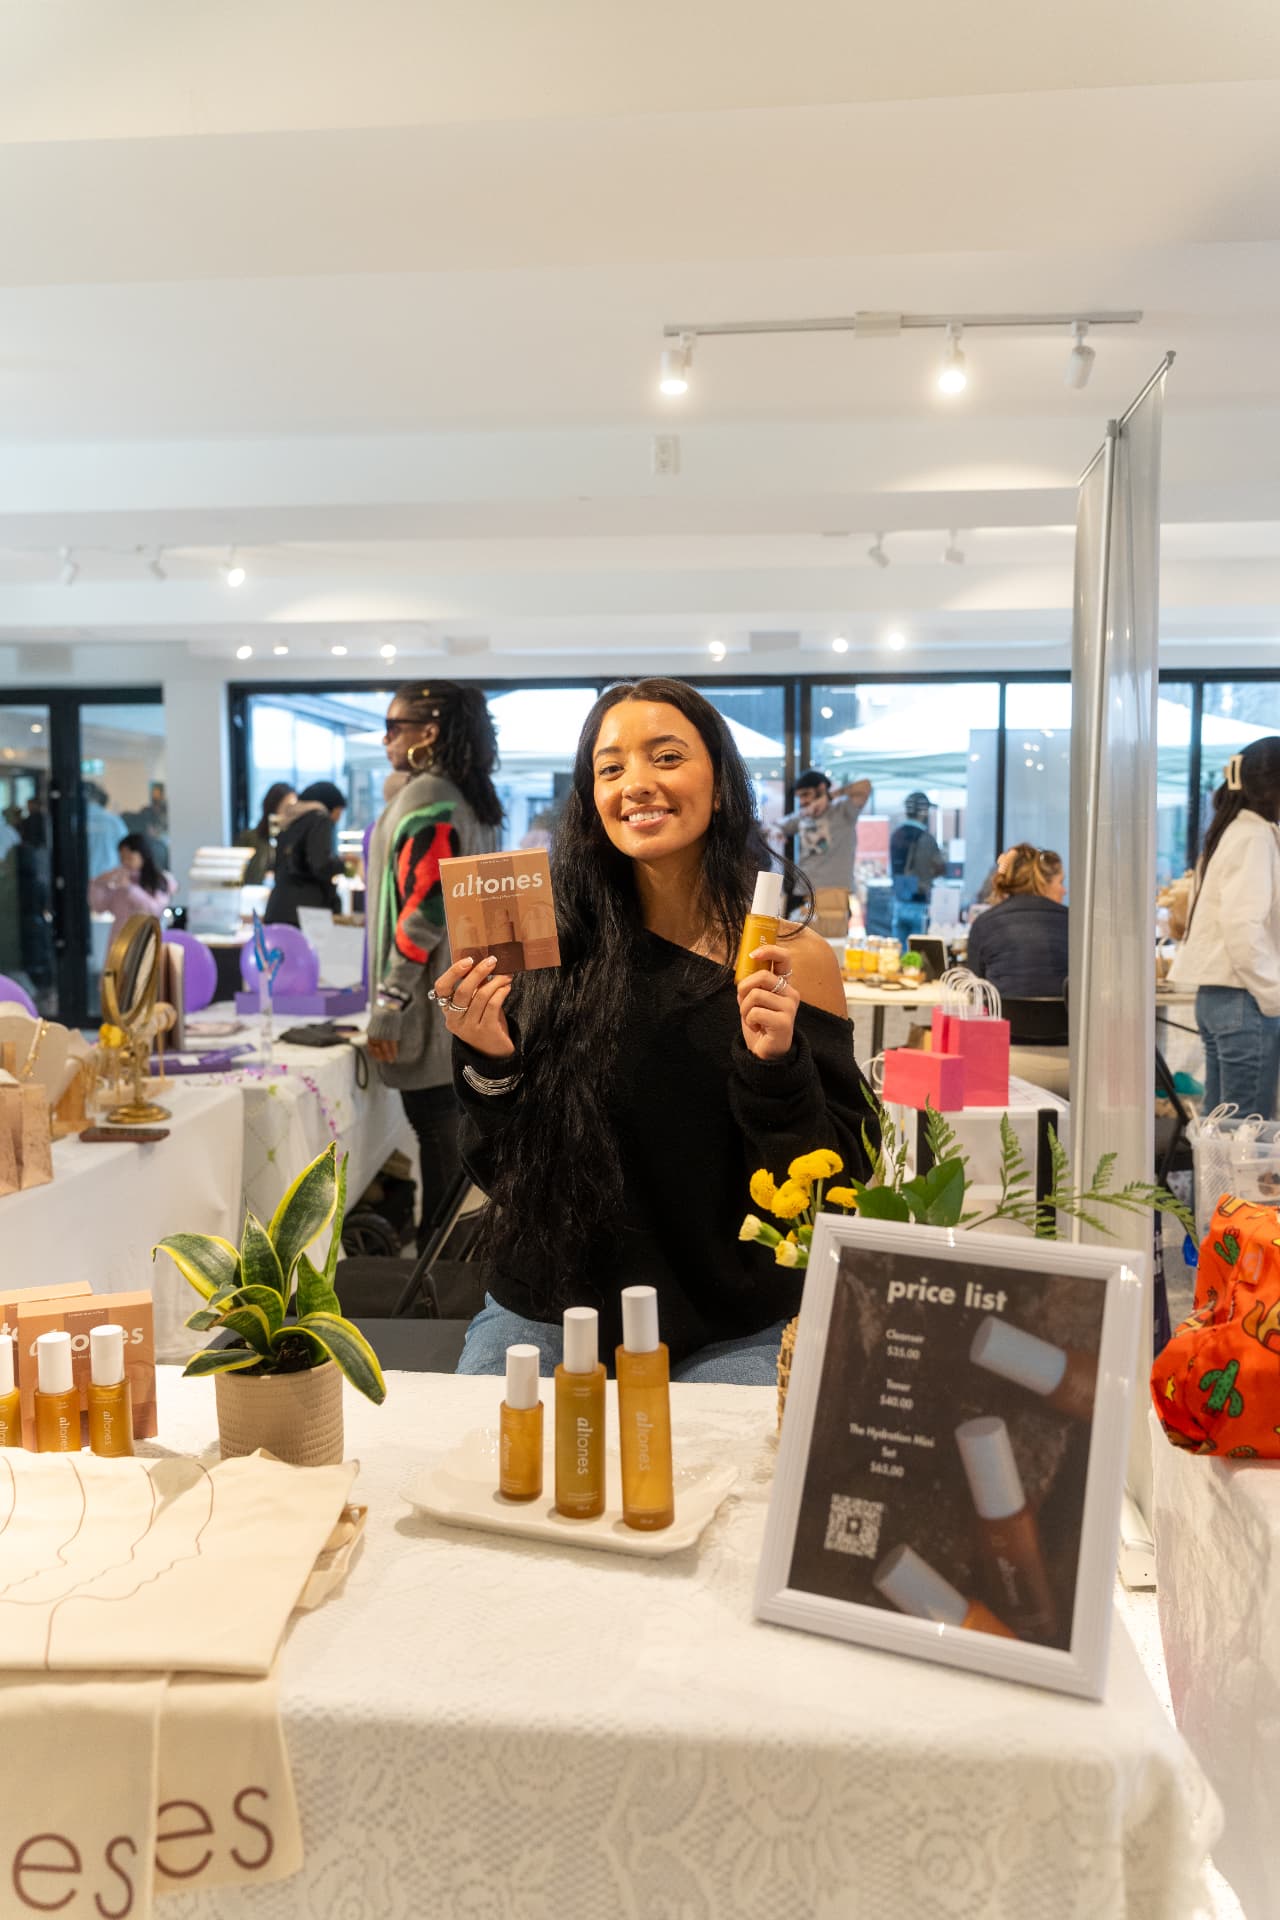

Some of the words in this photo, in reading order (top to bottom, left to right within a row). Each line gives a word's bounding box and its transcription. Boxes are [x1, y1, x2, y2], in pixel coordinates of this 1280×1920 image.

[452, 872, 543, 898] altones
[887, 1277, 957, 1306] price
[964, 1281, 1008, 1312] list
[886, 1379, 911, 1392] Toner
[880, 1395, 914, 1410] $40.00
[103, 1410, 114, 1447] altones
[635, 1411, 656, 1472] altones
[849, 1423, 865, 1435] The
[867, 1425, 912, 1444] Hydration
[576, 1417, 594, 1475] altones
